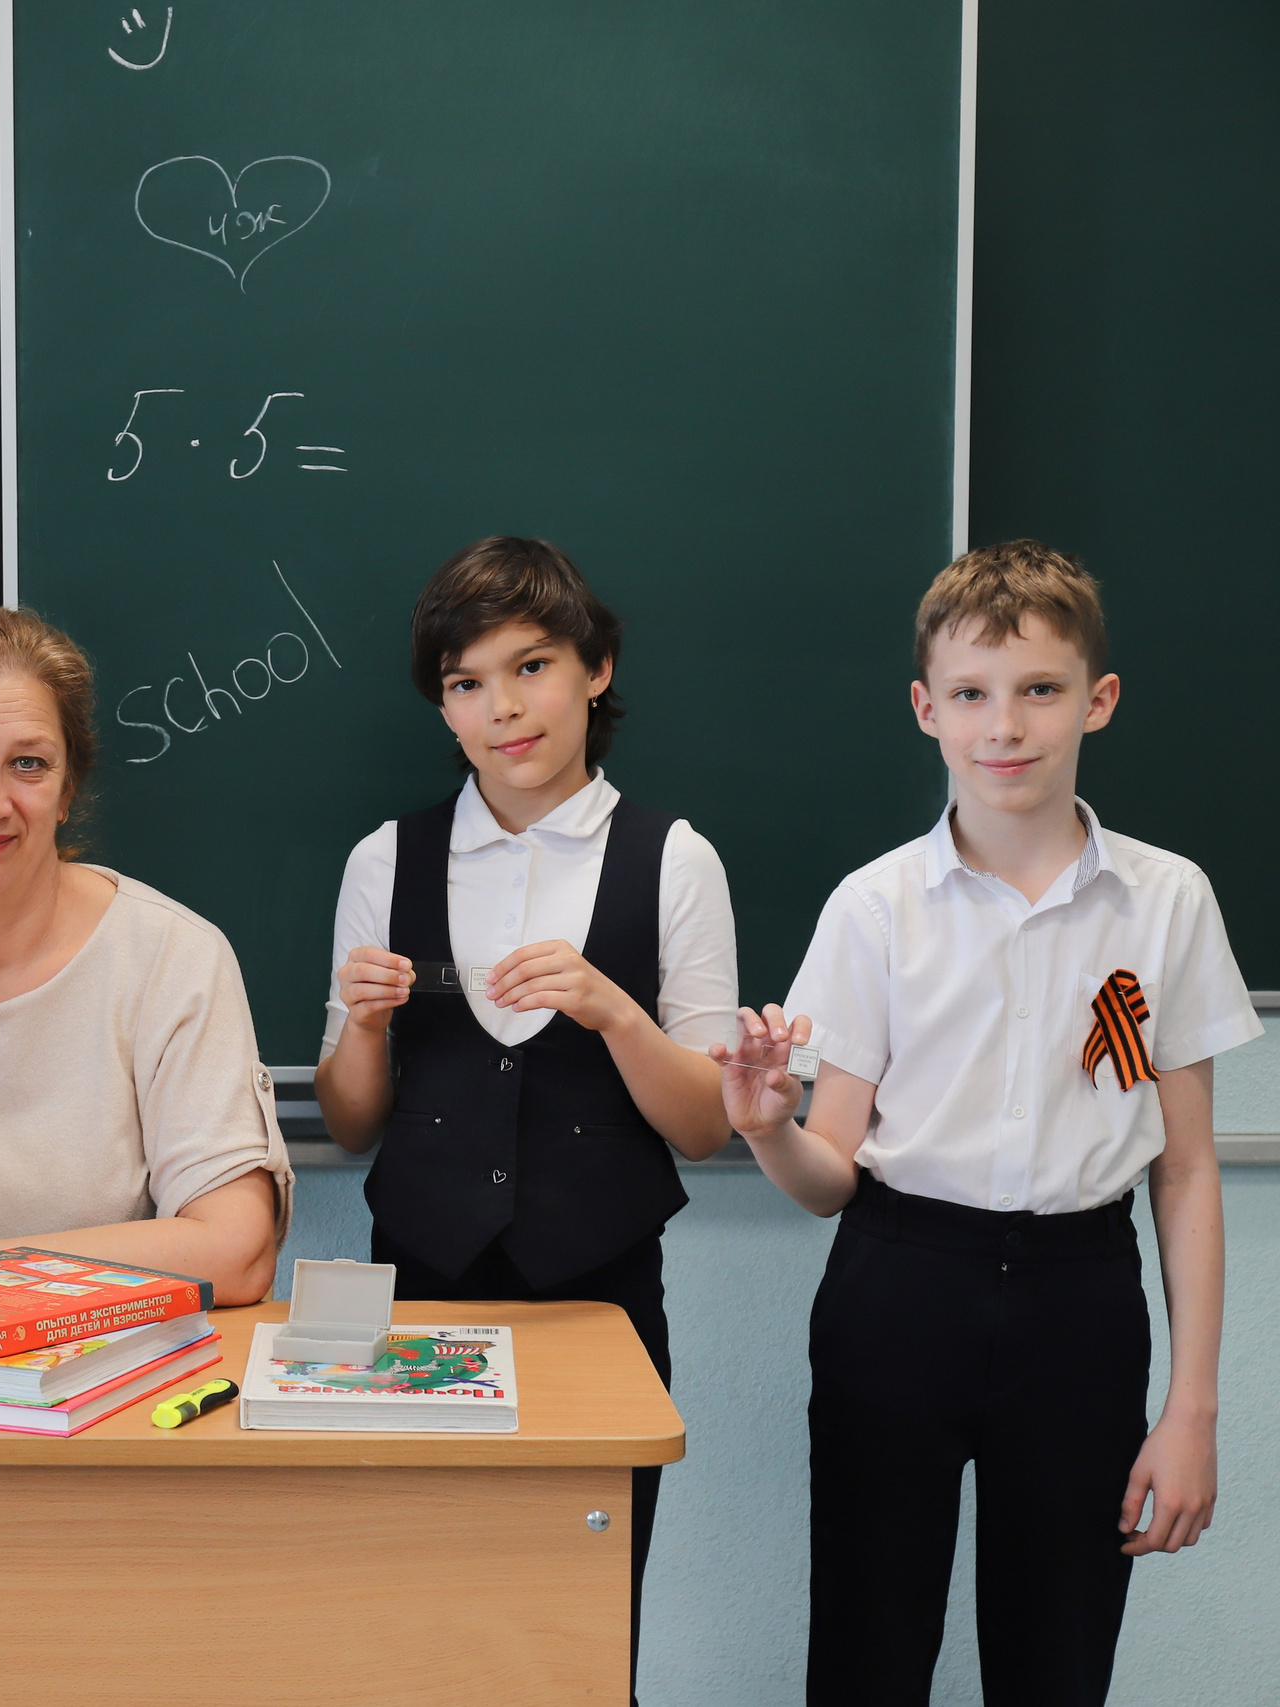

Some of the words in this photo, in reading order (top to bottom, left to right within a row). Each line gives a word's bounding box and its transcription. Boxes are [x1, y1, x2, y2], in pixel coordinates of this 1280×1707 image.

[35, 1314, 78, 1332] ОПЫТОВ
[80, 1311, 88, 1322] И
[90, 1293, 173, 1320] ЭКСПЕРИМЕНТОВ
[46, 1327, 68, 1343] ДЛЯ
[70, 1321, 101, 1337] ДЕТЕЙ
[103, 1318, 111, 1329] И
[113, 1306, 166, 1327] ВЗРОСЛЫХ
